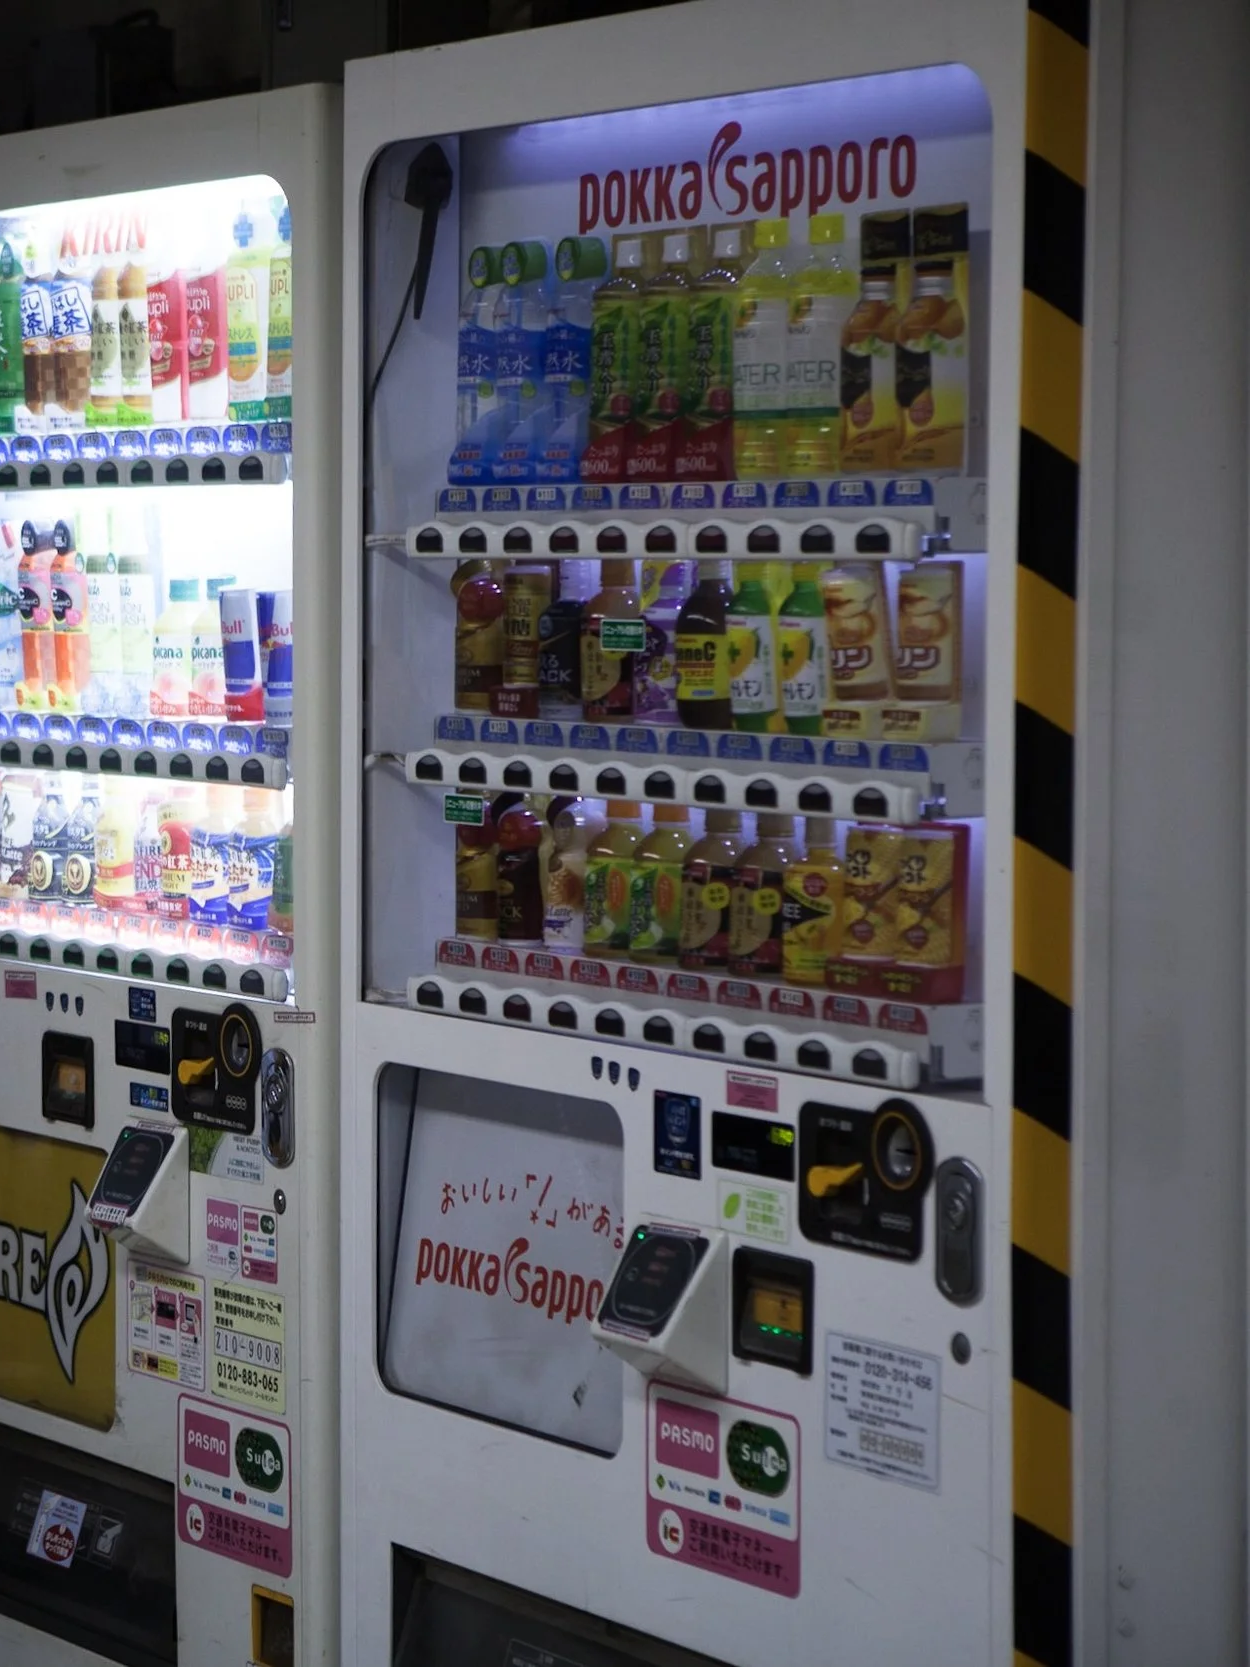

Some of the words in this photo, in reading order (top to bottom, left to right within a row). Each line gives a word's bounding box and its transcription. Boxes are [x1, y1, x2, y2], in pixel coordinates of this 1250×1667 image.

[148, 300, 169, 316] upli
[208, 1212, 238, 1231] PASMO
[217, 1361, 279, 1394] 0120-883-065
[187, 1429, 227, 1456] PASMO
[660, 1422, 715, 1454] PASMO
[246, 1447, 281, 1472] Suica
[741, 1443, 787, 1472] Suica
